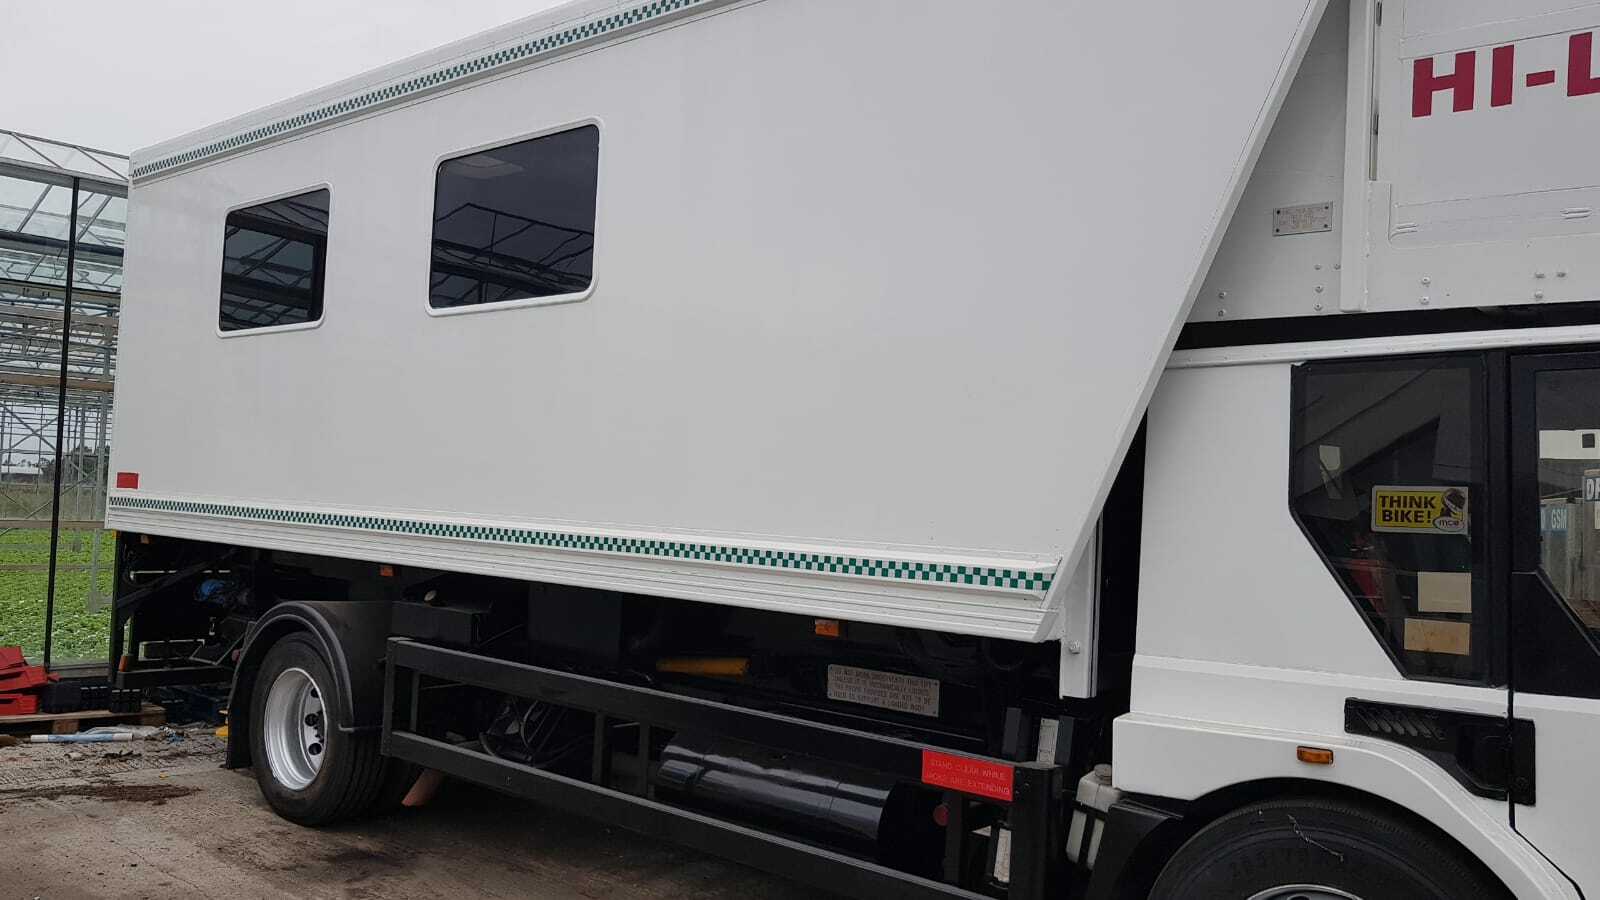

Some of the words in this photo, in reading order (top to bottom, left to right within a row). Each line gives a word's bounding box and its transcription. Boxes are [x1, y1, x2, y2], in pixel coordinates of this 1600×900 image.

[1412, 31, 1600, 117] HI-L
[1379, 495, 1436, 509] THINK
[1382, 509, 1431, 523] BIKE!
[982, 769, 1007, 780] WHILE
[967, 779, 1010, 795] EXTENDING
